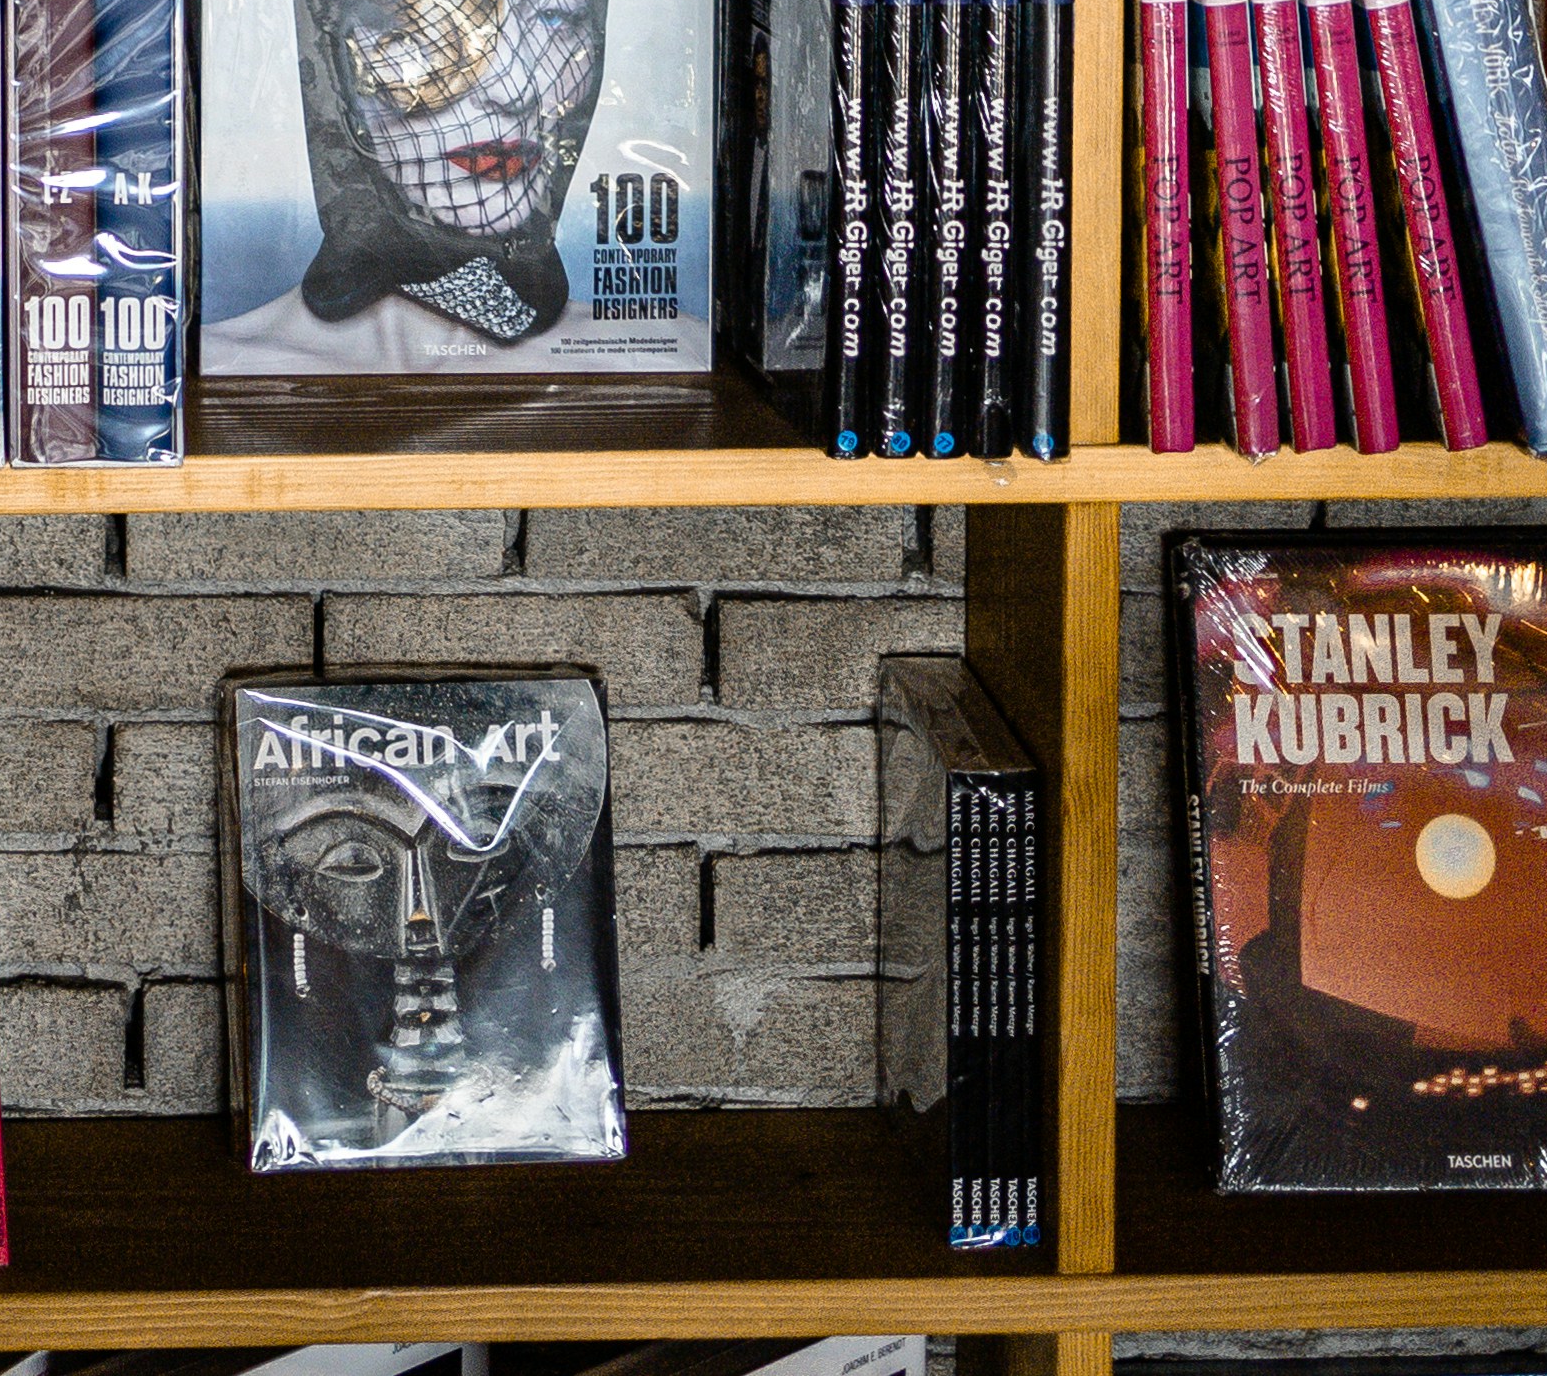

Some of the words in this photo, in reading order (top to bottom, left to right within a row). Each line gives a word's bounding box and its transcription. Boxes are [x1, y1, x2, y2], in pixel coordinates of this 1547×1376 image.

[844, 97, 864, 172] www
[589, 173, 680, 245] 100
[1224, 157, 1254, 225] POP
[592, 248, 677, 265] CONTEMPORARY
[592, 265, 677, 295] FASHION
[837, 221, 867, 290] Giger
[1228, 236, 1262, 304] ART
[592, 296, 679, 321] DESIGNERS
[843, 298, 860, 358] com
[423, 343, 487, 357] TASCHEN
[1231, 612, 1504, 686] STANLEY
[254, 716, 454, 771] African
[477, 710, 561, 764] Art
[1235, 692, 1516, 765] KUBRICK
[254, 776, 290, 787] STEFAN
[291, 775, 350, 786] EISENHOFER
[1023, 790, 1035, 831] MARC
[1023, 836, 1036, 902] CHAGALL
[1447, 1154, 1512, 1168] TASCHEN
